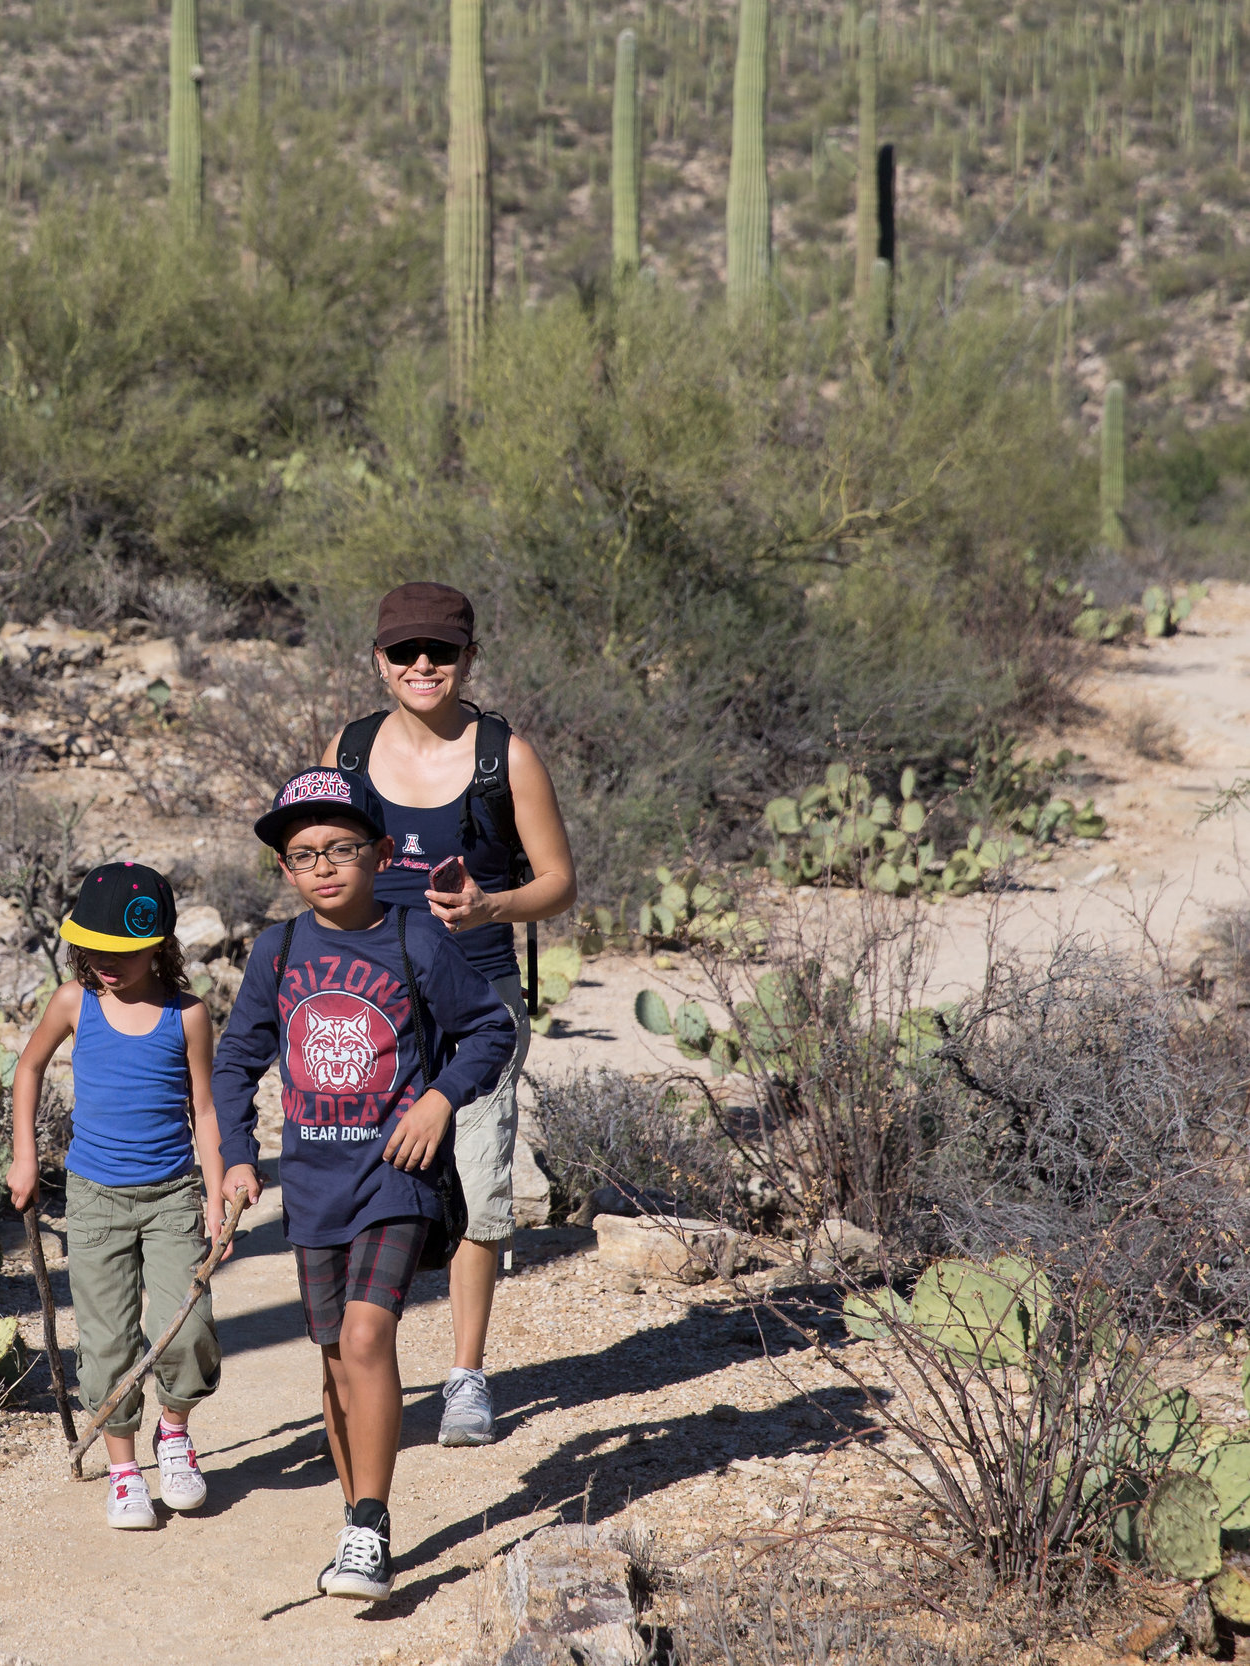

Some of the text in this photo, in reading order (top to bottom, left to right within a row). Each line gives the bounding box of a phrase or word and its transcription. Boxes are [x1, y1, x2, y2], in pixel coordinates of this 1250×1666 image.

[283, 771, 344, 794] ARIZONA
[278, 781, 351, 807] WILDCATS
[402, 834, 423, 854] A
[301, 1126, 337, 1141] BEAR
